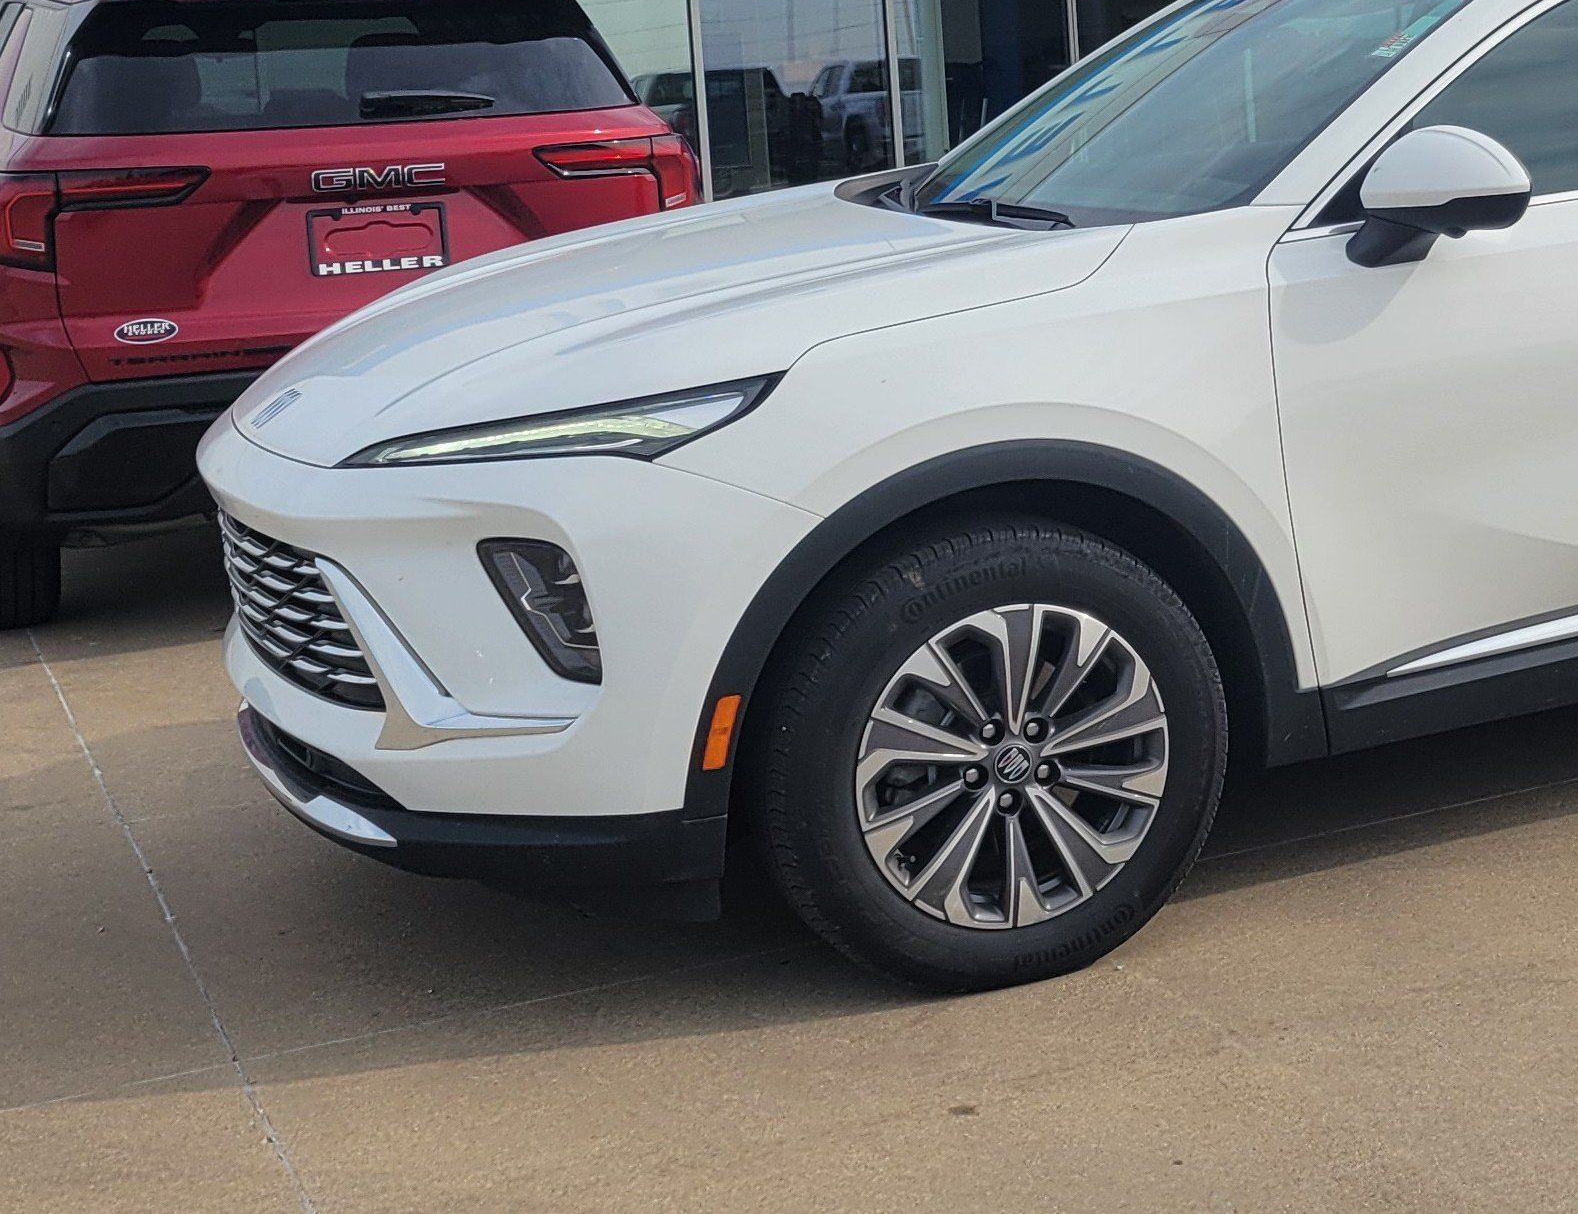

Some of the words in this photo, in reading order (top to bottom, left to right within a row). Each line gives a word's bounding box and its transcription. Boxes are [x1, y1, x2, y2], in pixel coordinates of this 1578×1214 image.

[311, 163, 445, 193] GMC
[386, 203, 411, 212] BEST
[318, 254, 444, 276] HELLER
[123, 322, 171, 335] HELLER
